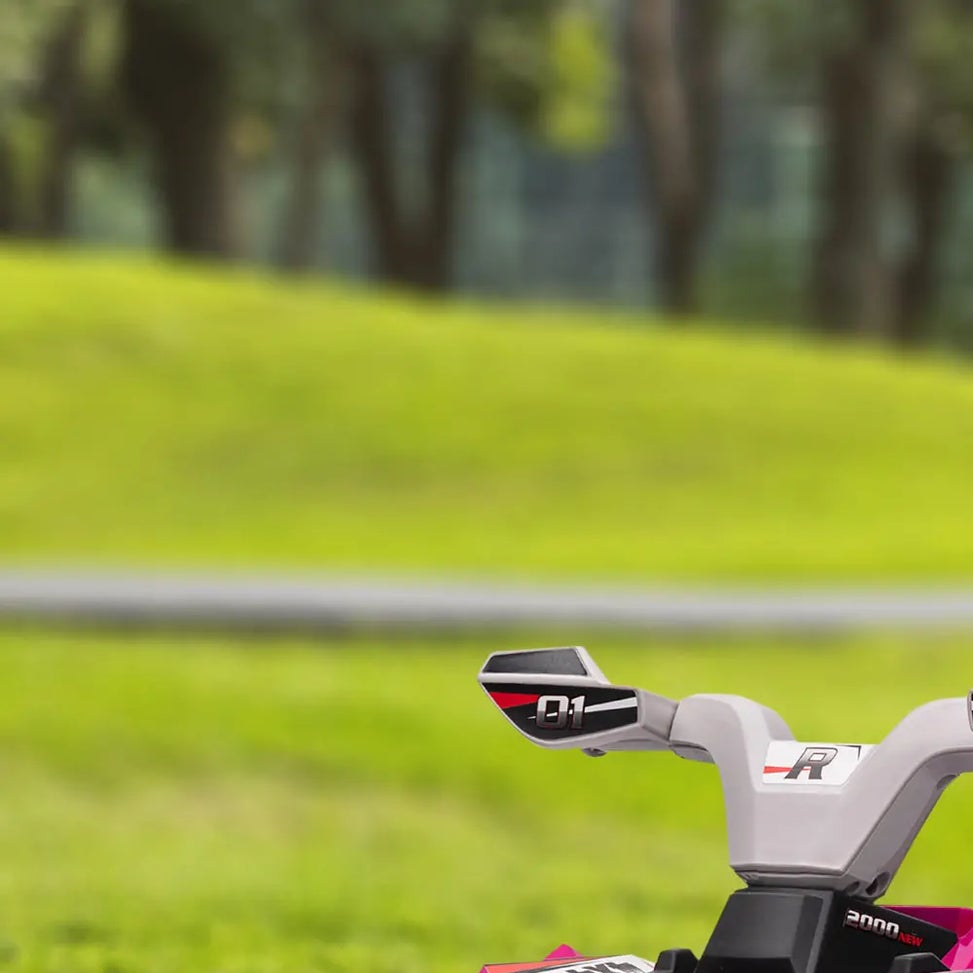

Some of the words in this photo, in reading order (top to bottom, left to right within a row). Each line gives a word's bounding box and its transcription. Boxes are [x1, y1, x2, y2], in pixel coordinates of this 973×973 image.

[536, 695, 585, 729] 01
[784, 747, 838, 780] R
[845, 909, 900, 940] 2000
[898, 932, 923, 947] NEW
